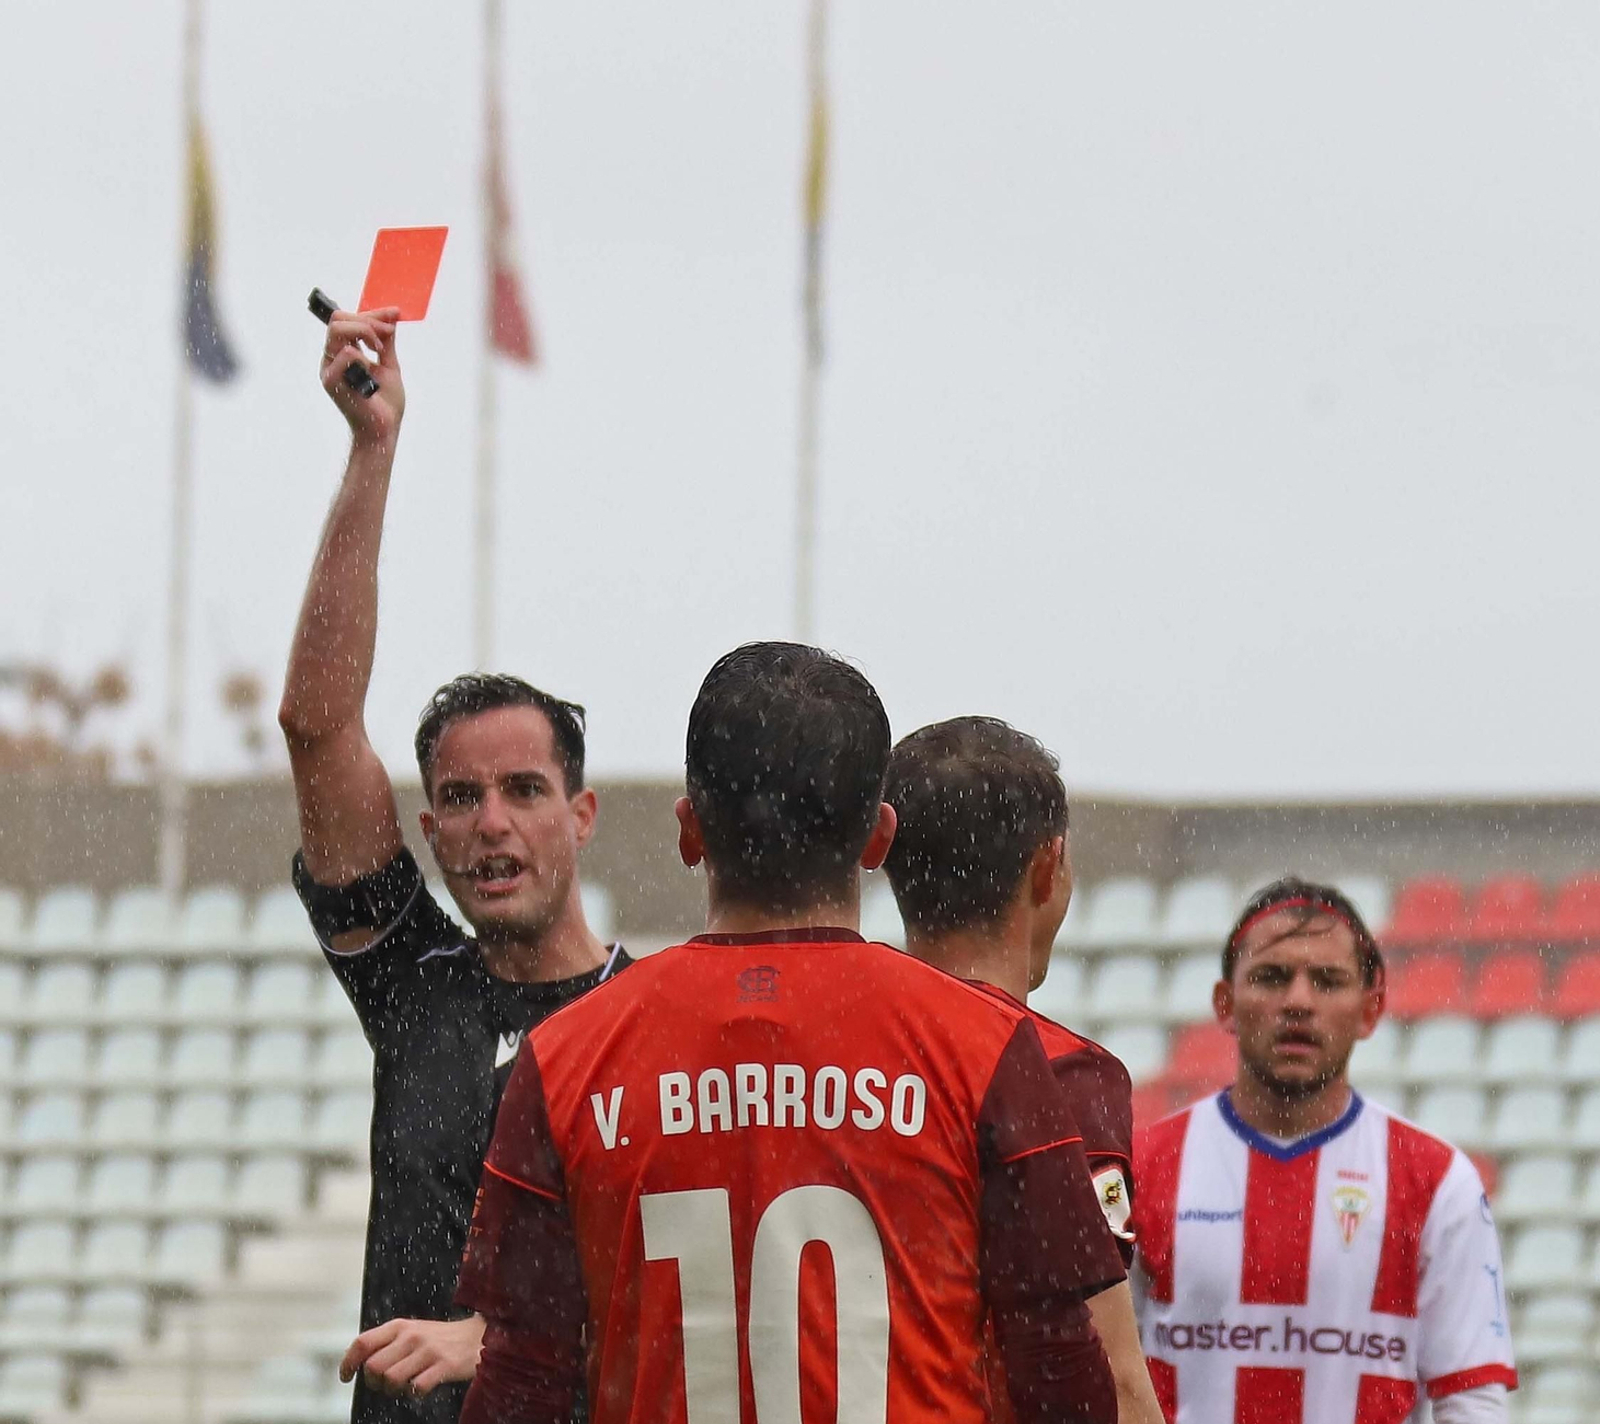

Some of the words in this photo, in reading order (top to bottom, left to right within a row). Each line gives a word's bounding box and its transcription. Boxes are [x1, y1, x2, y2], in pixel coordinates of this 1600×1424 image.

[590, 1085, 632, 1151] V.
[658, 1062, 927, 1138] BARROSO
[1155, 1316, 1407, 1362] master.house
